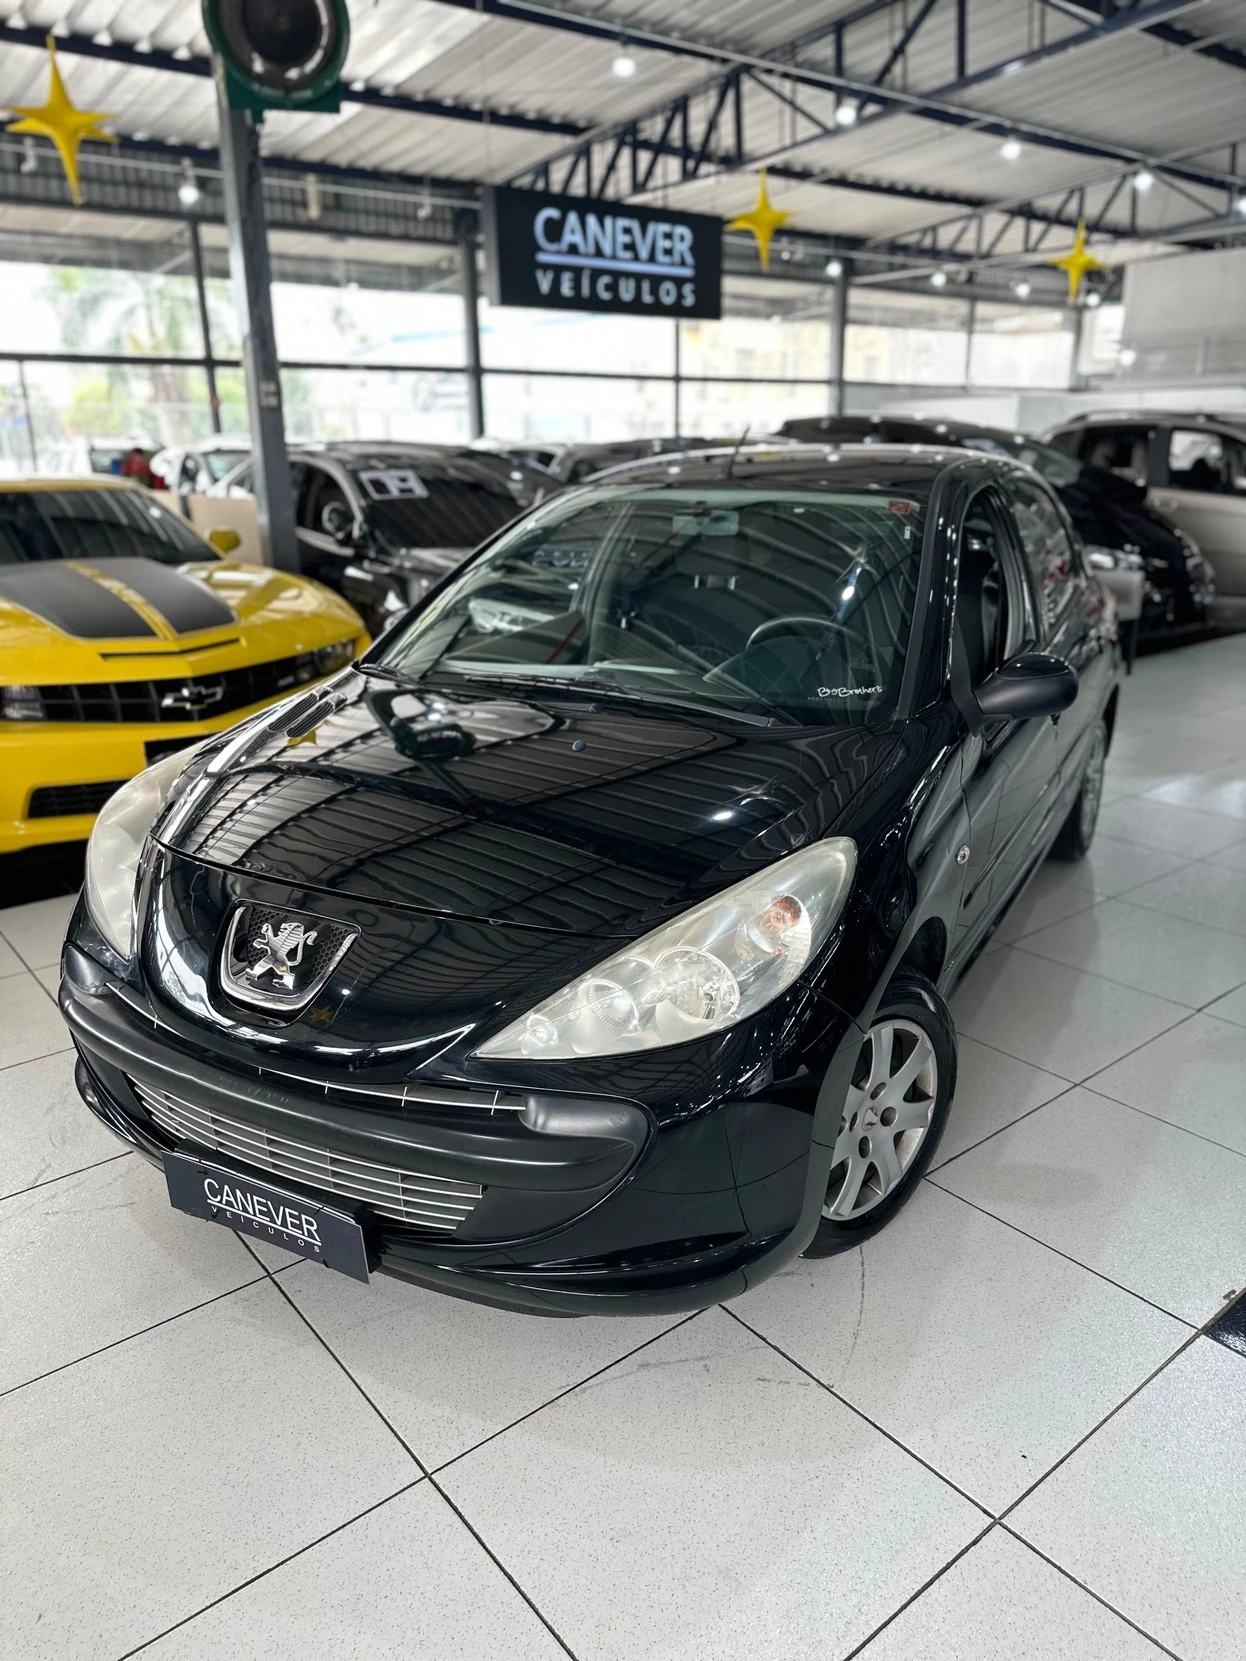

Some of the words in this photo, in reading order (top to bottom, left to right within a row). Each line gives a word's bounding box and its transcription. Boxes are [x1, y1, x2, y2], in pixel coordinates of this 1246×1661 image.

[534, 206, 695, 266] CANEVER
[535, 268, 696, 307] VEÍCULOS
[203, 1178, 321, 1242] CANEVER
[211, 1205, 321, 1253] VEICULOS
